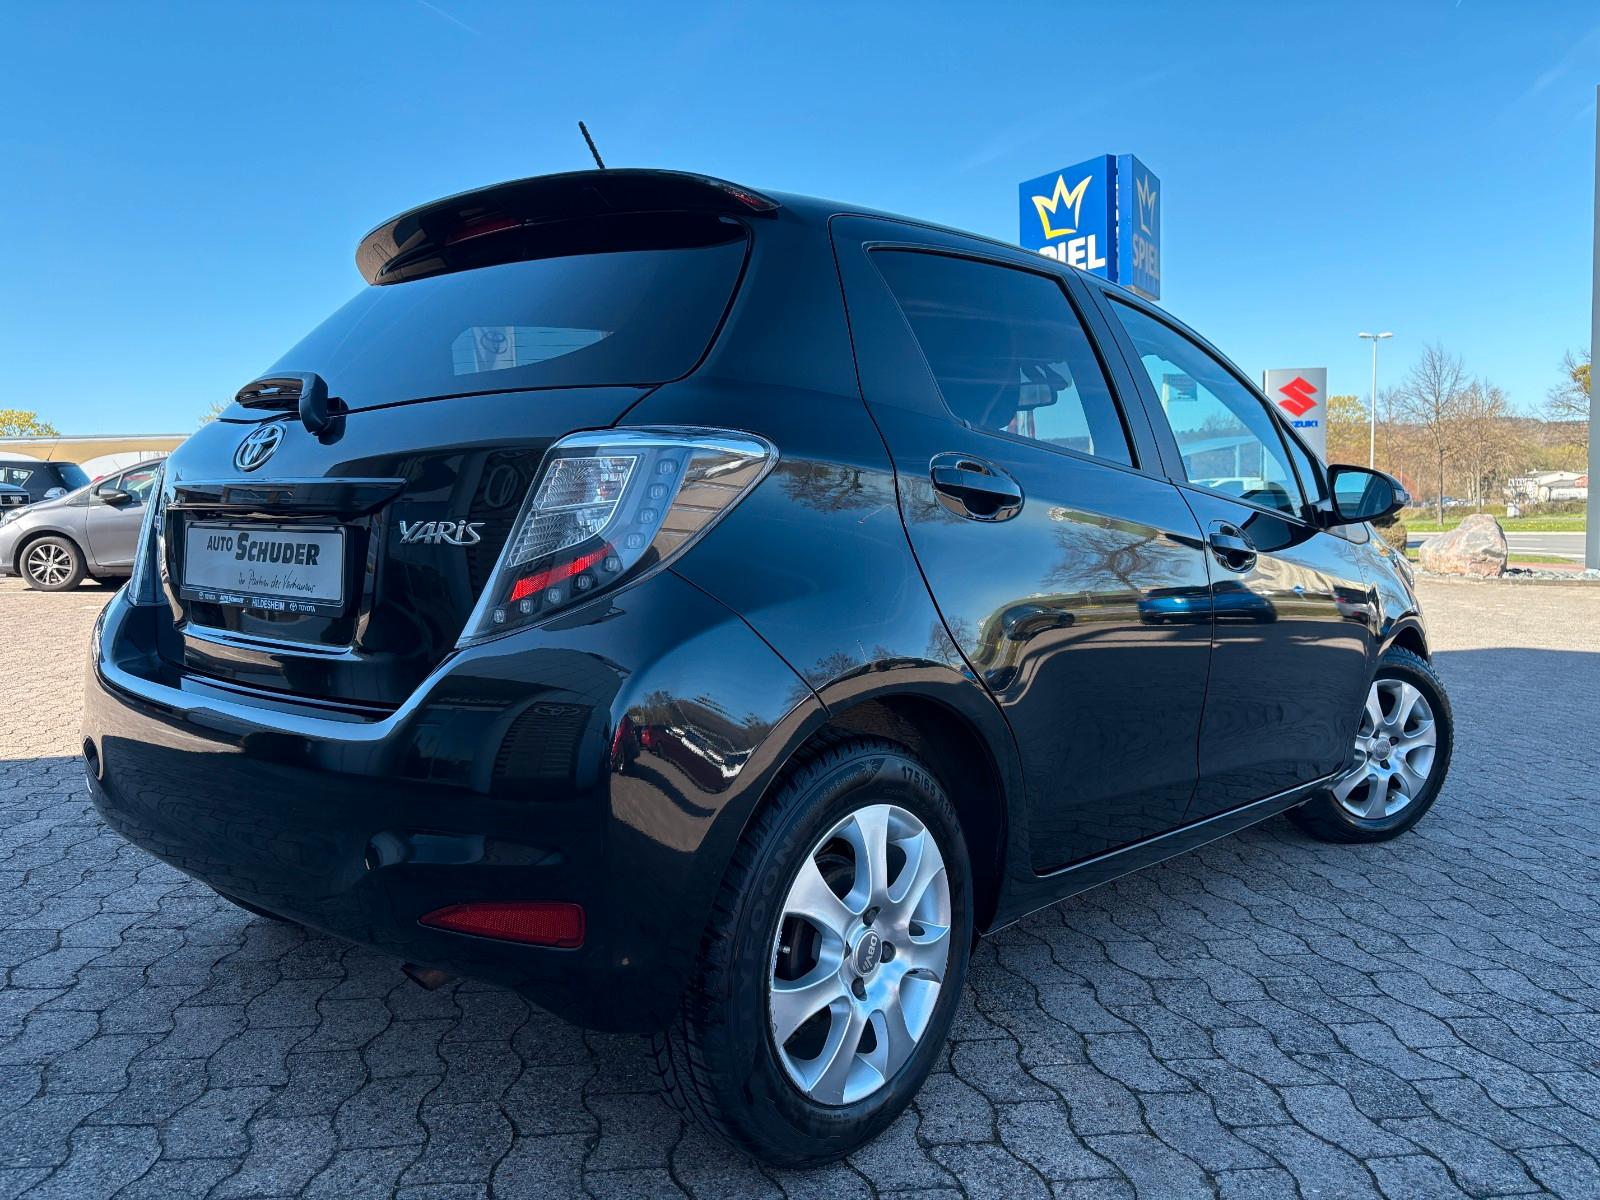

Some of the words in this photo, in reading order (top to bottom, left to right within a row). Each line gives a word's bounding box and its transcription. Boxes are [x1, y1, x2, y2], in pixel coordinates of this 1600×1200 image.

[1133, 232, 1159, 280] SPIEL
[207, 535, 233, 552] AUTO
[235, 532, 321, 566] SCHUDER
[251, 597, 285, 612] HILDESHEIM
[298, 604, 316, 613] TOYOTA
[902, 765, 936, 797] 175/65
